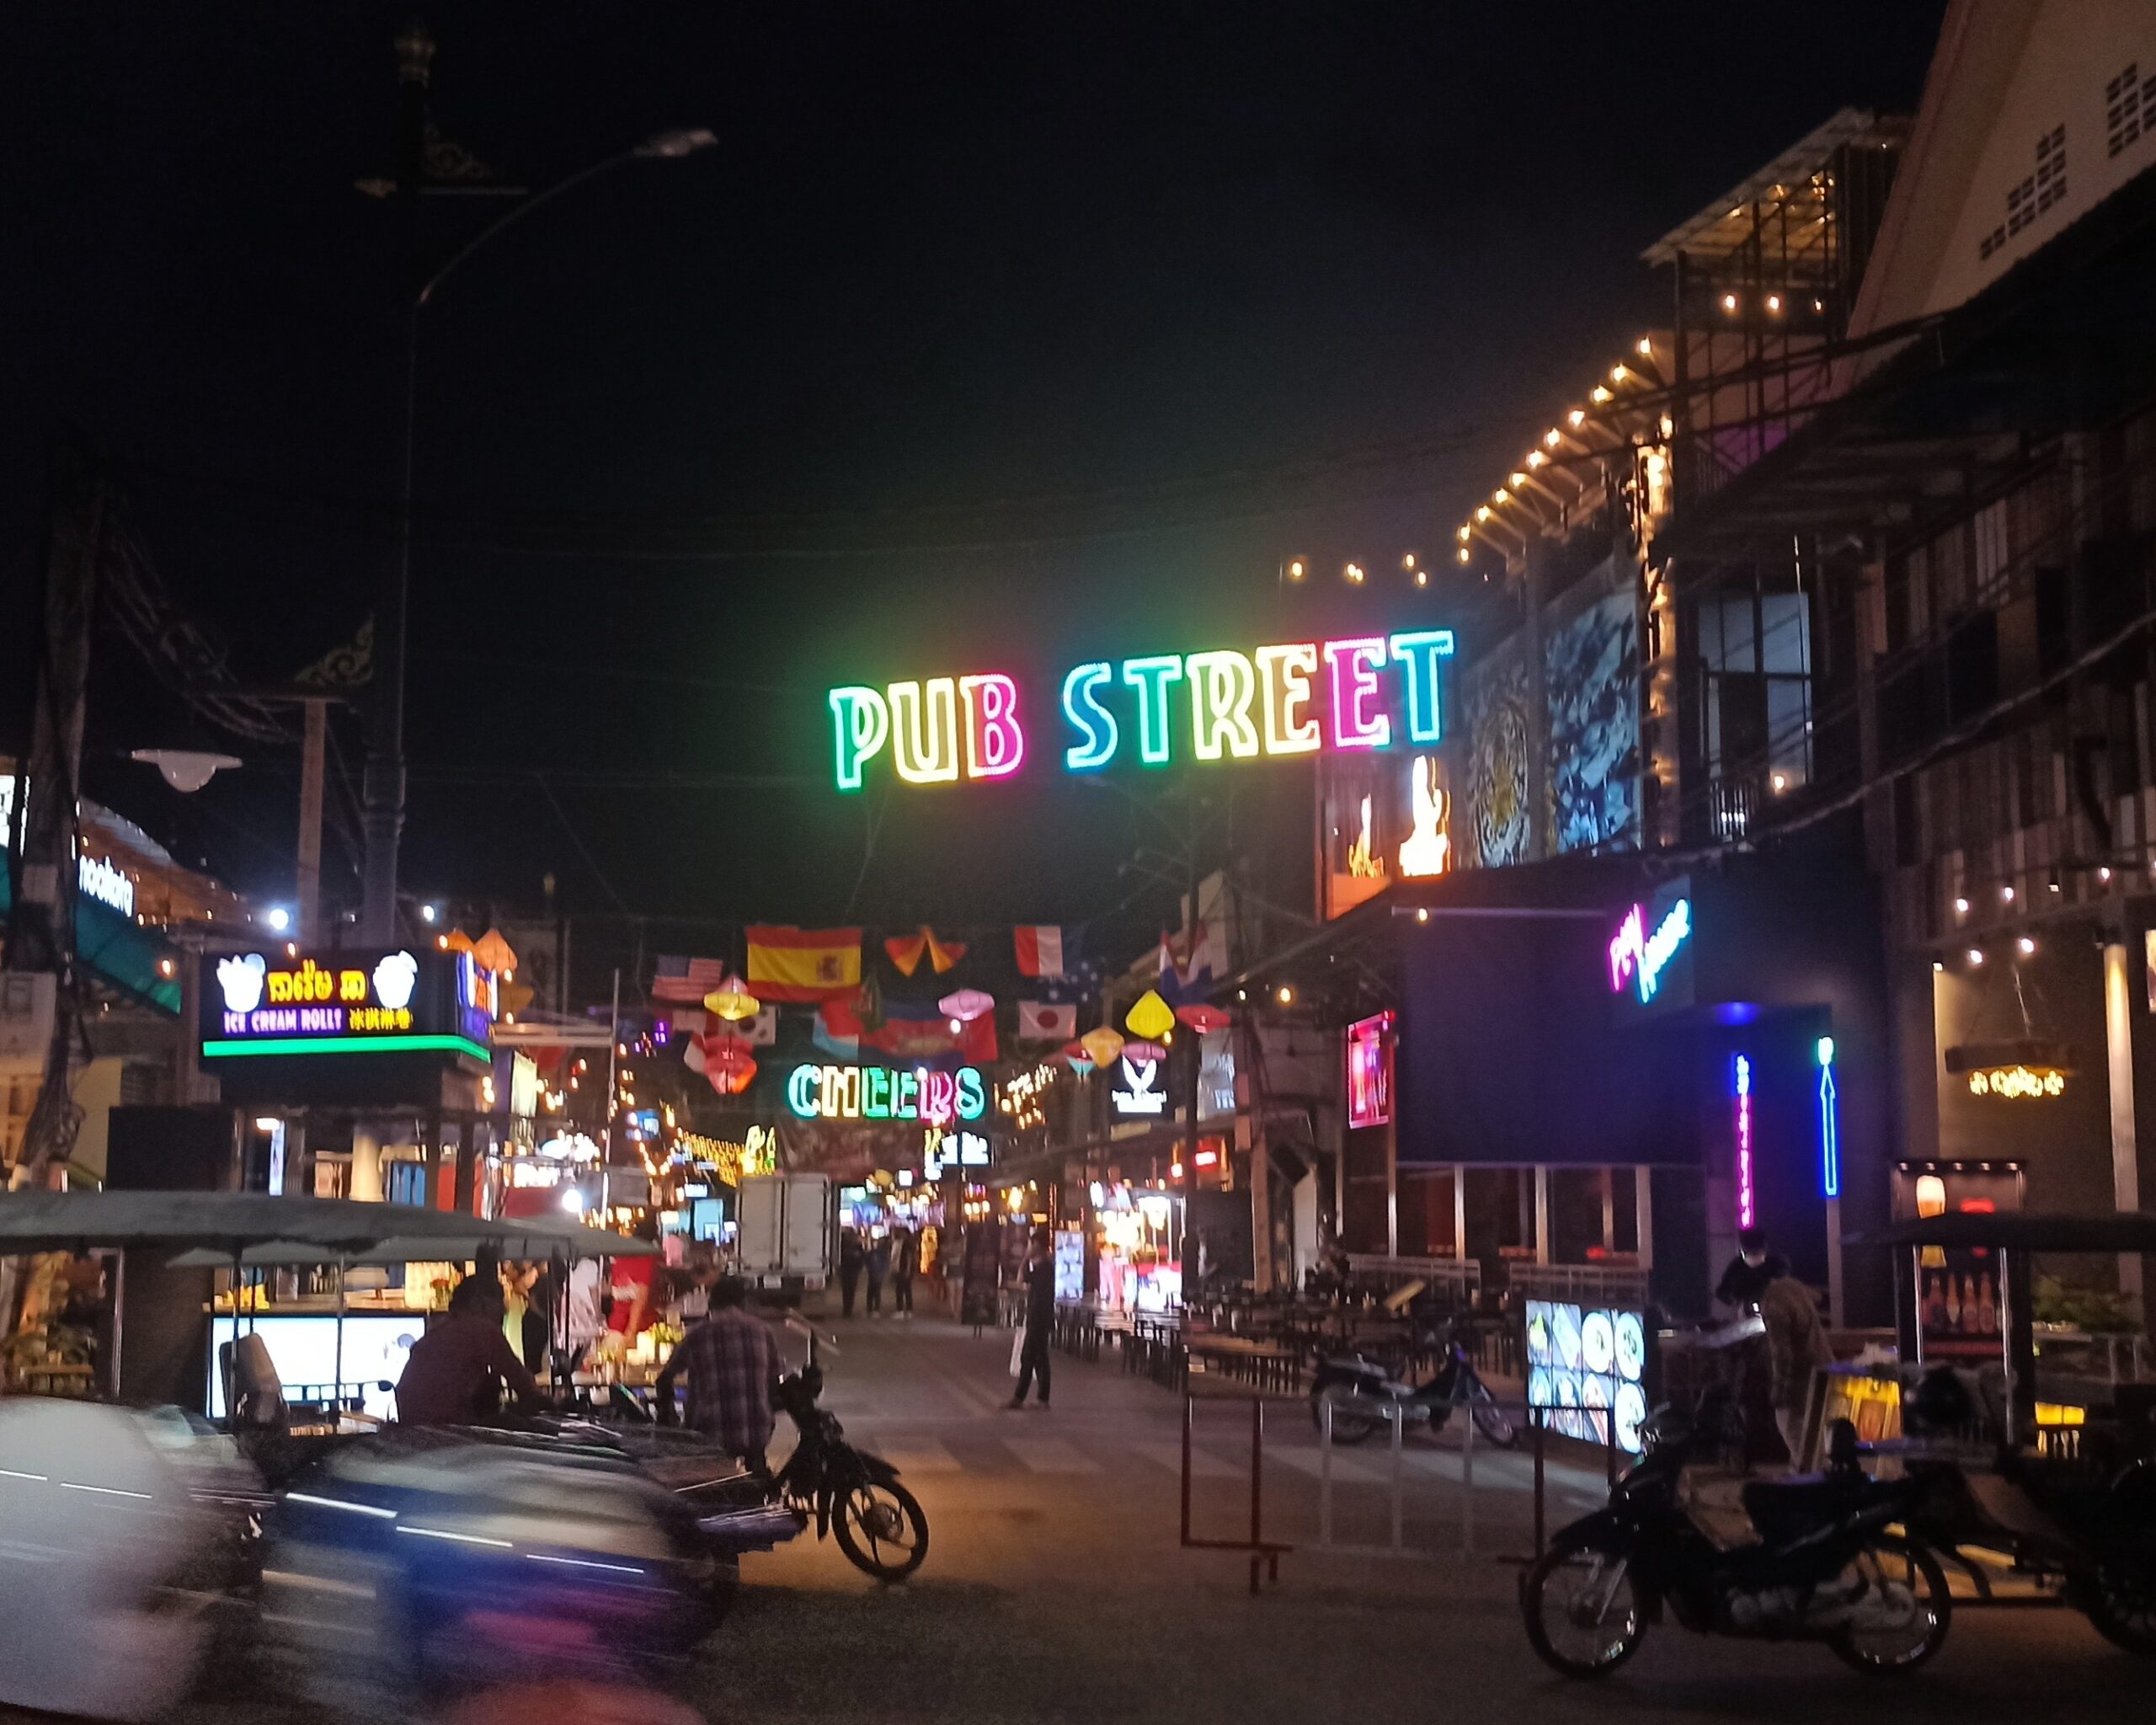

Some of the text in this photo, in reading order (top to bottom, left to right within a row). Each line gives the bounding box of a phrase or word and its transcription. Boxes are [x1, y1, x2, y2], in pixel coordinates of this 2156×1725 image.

[828, 629, 1454, 789] PUB STREET
[223, 1011, 247, 1033] ICE
[252, 1010, 297, 1033] CREAM
[787, 1063, 985, 1121] CHEERS
